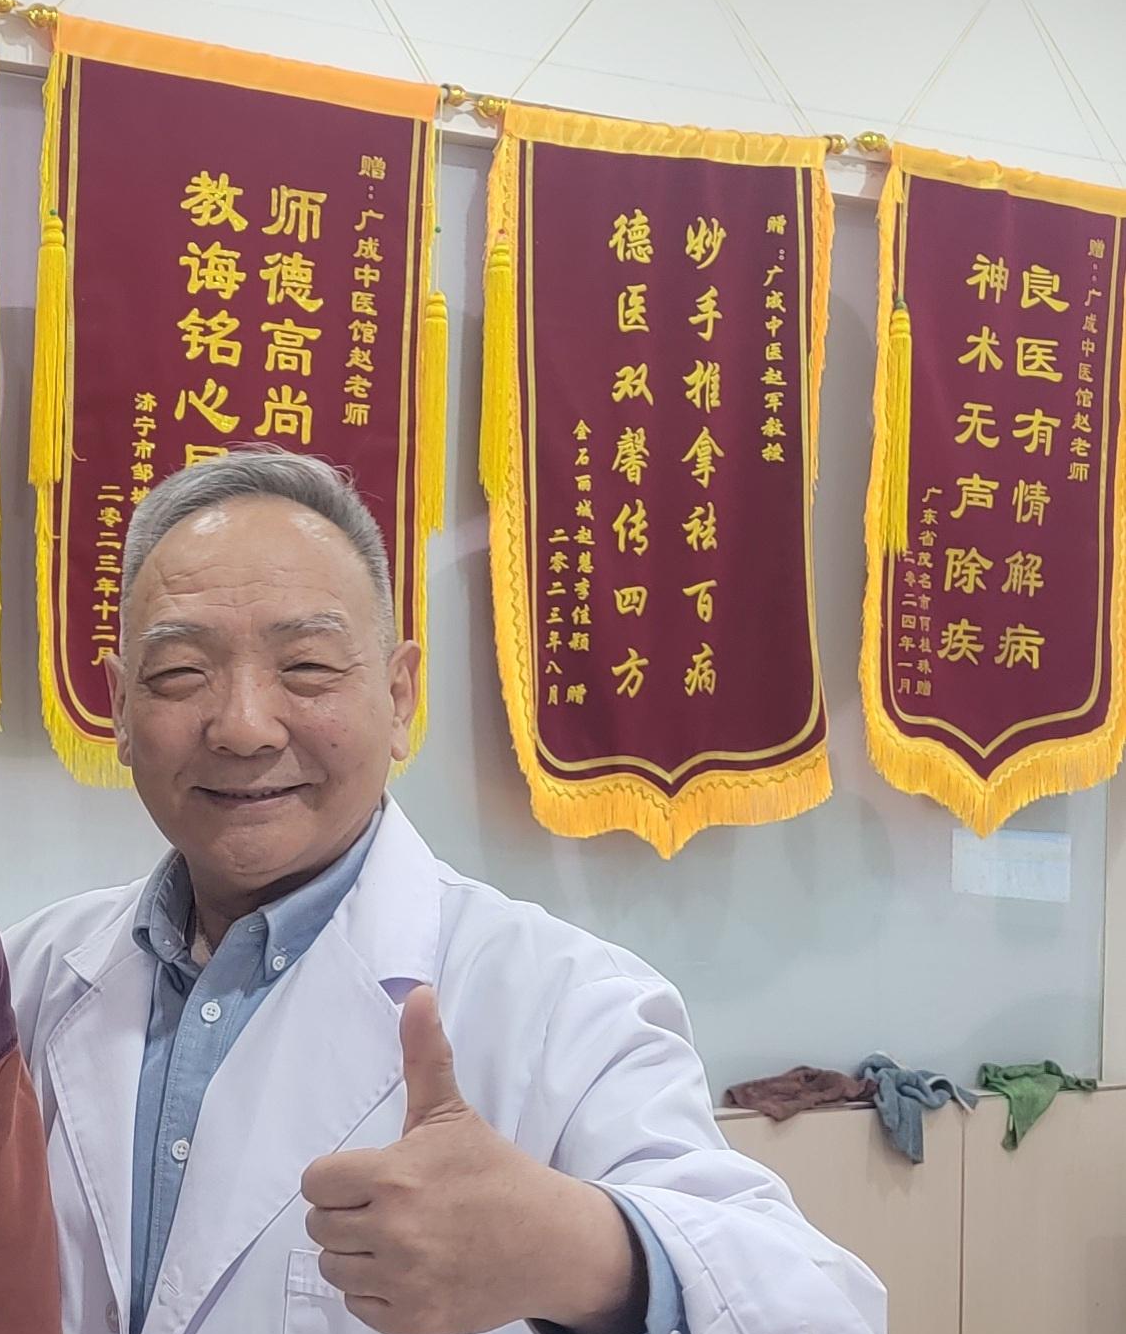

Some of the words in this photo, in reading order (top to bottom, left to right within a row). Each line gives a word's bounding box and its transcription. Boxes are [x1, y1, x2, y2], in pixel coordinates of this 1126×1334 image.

[253, 184, 328, 446] 师德高尚
[609, 208, 654, 698] 德医双馨传四方
[681, 216, 727, 697] 妙手推拿祛百病
[937, 253, 1009, 665] 神术无声除疾
[994, 264, 1070, 670] 良医有情解病
[90, 485, 124, 667] 二零二三年十二月
[545, 528, 570, 705] 二零二三年八月
